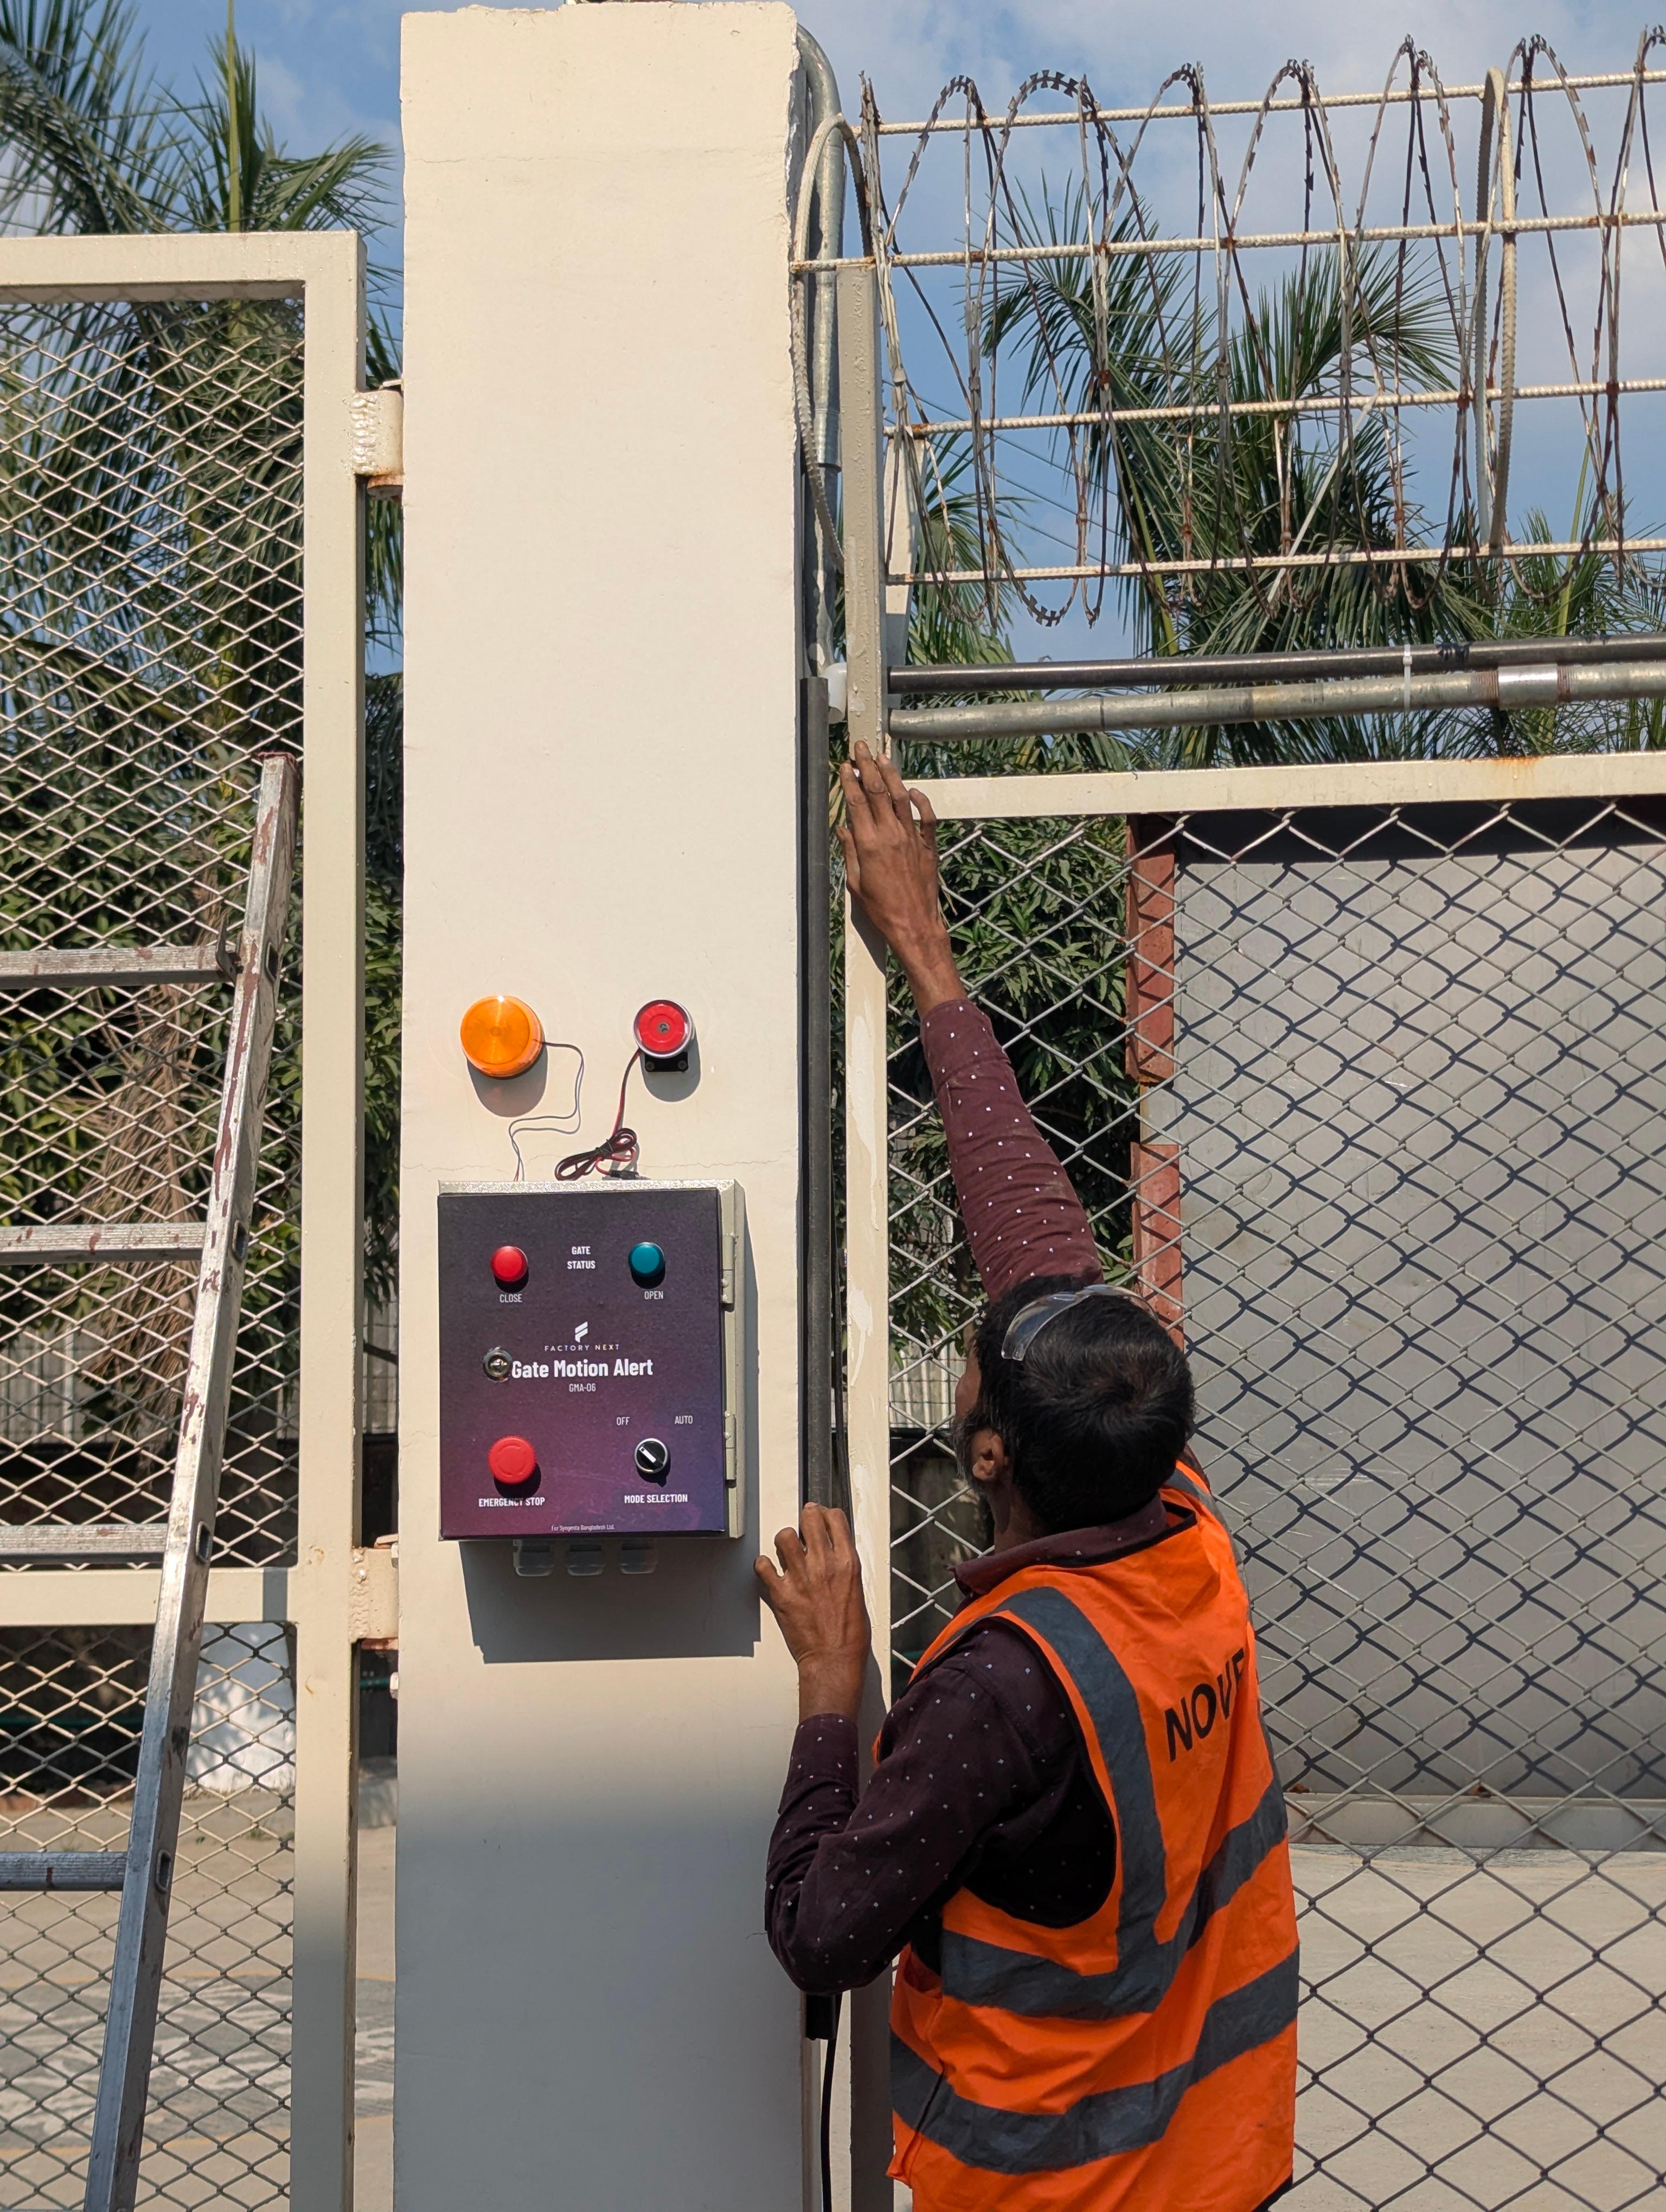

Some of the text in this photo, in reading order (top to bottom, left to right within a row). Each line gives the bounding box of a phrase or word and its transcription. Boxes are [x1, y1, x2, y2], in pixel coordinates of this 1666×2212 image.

[571, 1246, 591, 1255] GATE
[567, 1261, 595, 1269] STATUS
[499, 1294, 522, 1303] CLOSE
[644, 1291, 664, 1299] OPEN
[512, 1358, 653, 1379] Gate Motion Alert
[569, 1383, 596, 1392] GMA-06
[616, 1417, 630, 1426] OFF
[675, 1415, 693, 1424] AUTO
[478, 1497, 545, 1507] EMERGENCY STOP
[624, 1494, 688, 1503] MODE SELECTION
